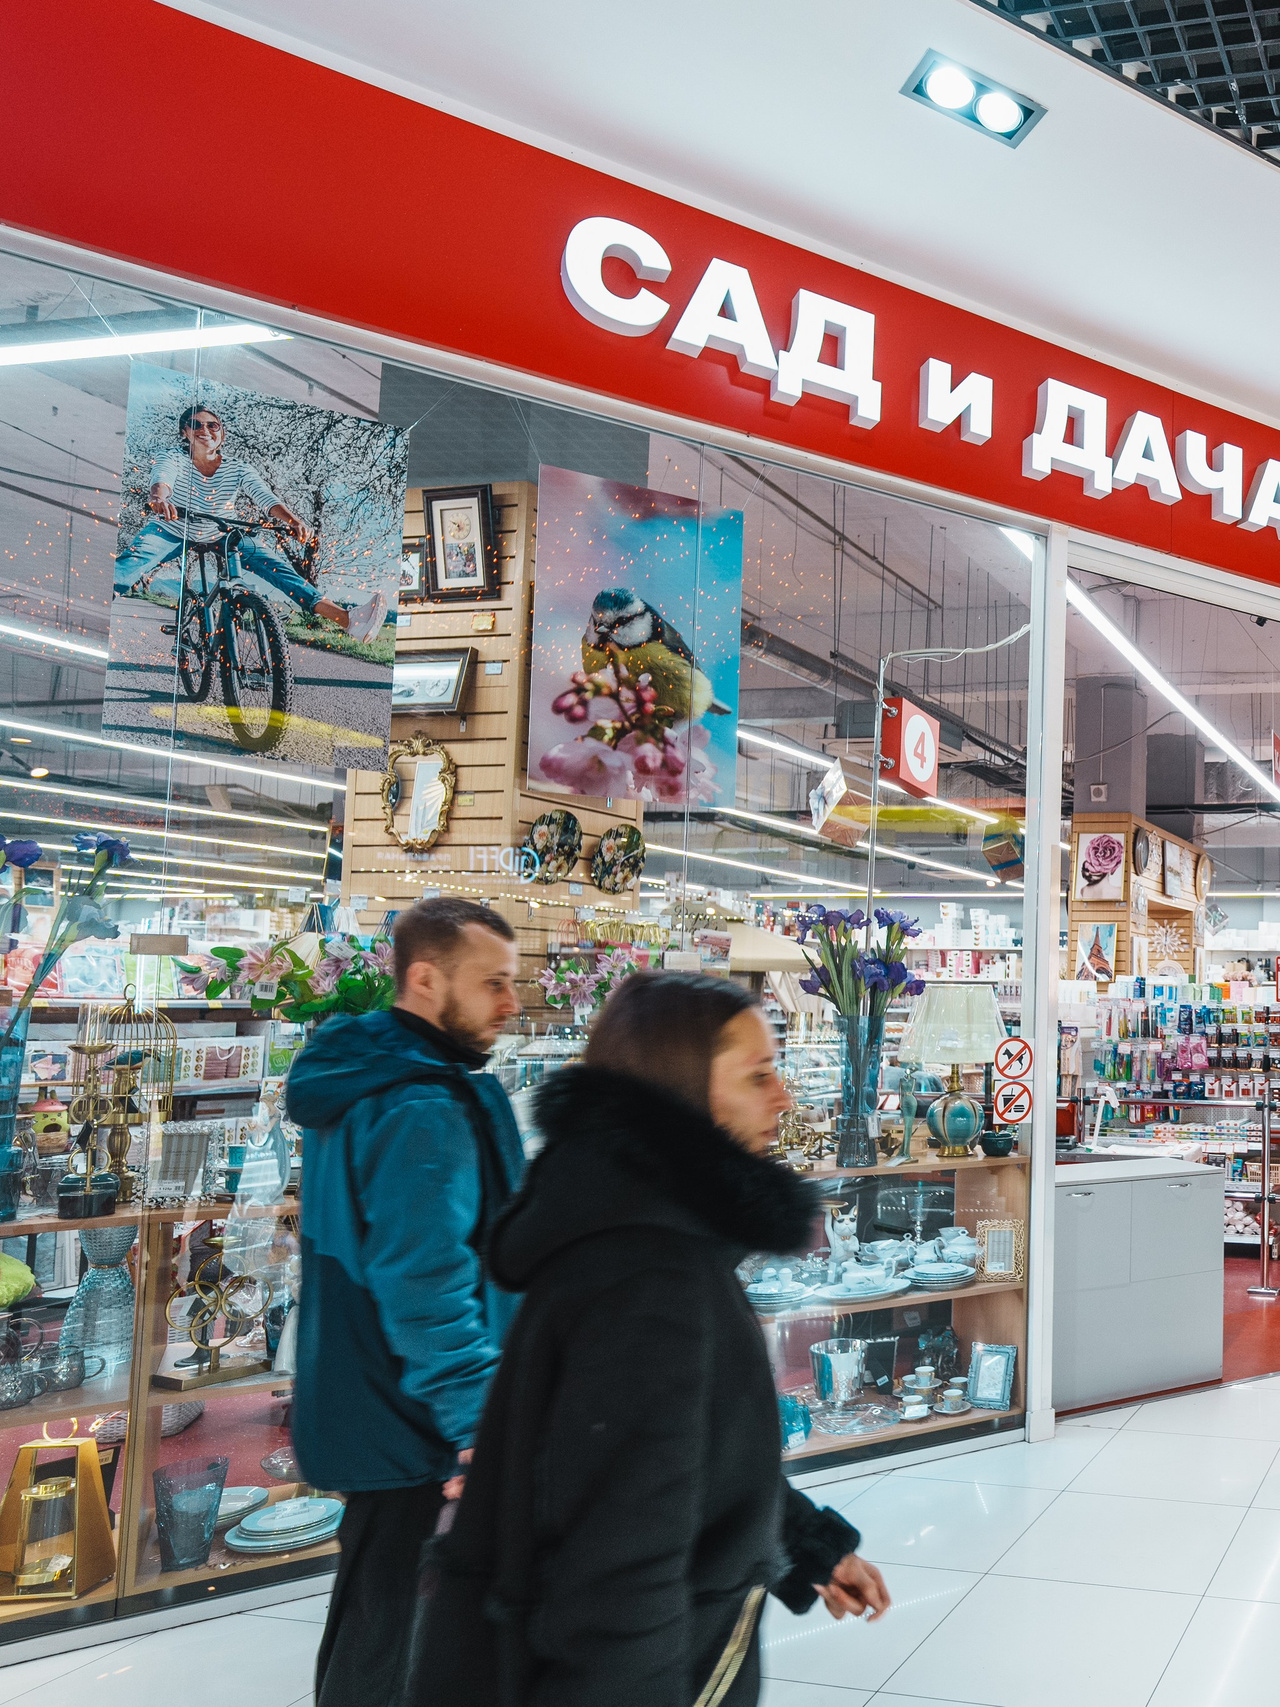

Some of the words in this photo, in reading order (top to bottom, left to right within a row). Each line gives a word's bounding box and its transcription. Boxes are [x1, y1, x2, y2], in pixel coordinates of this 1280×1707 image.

[562, 216, 882, 429] САД
[920, 357, 993, 445] и
[912, 730, 928, 770] 4
